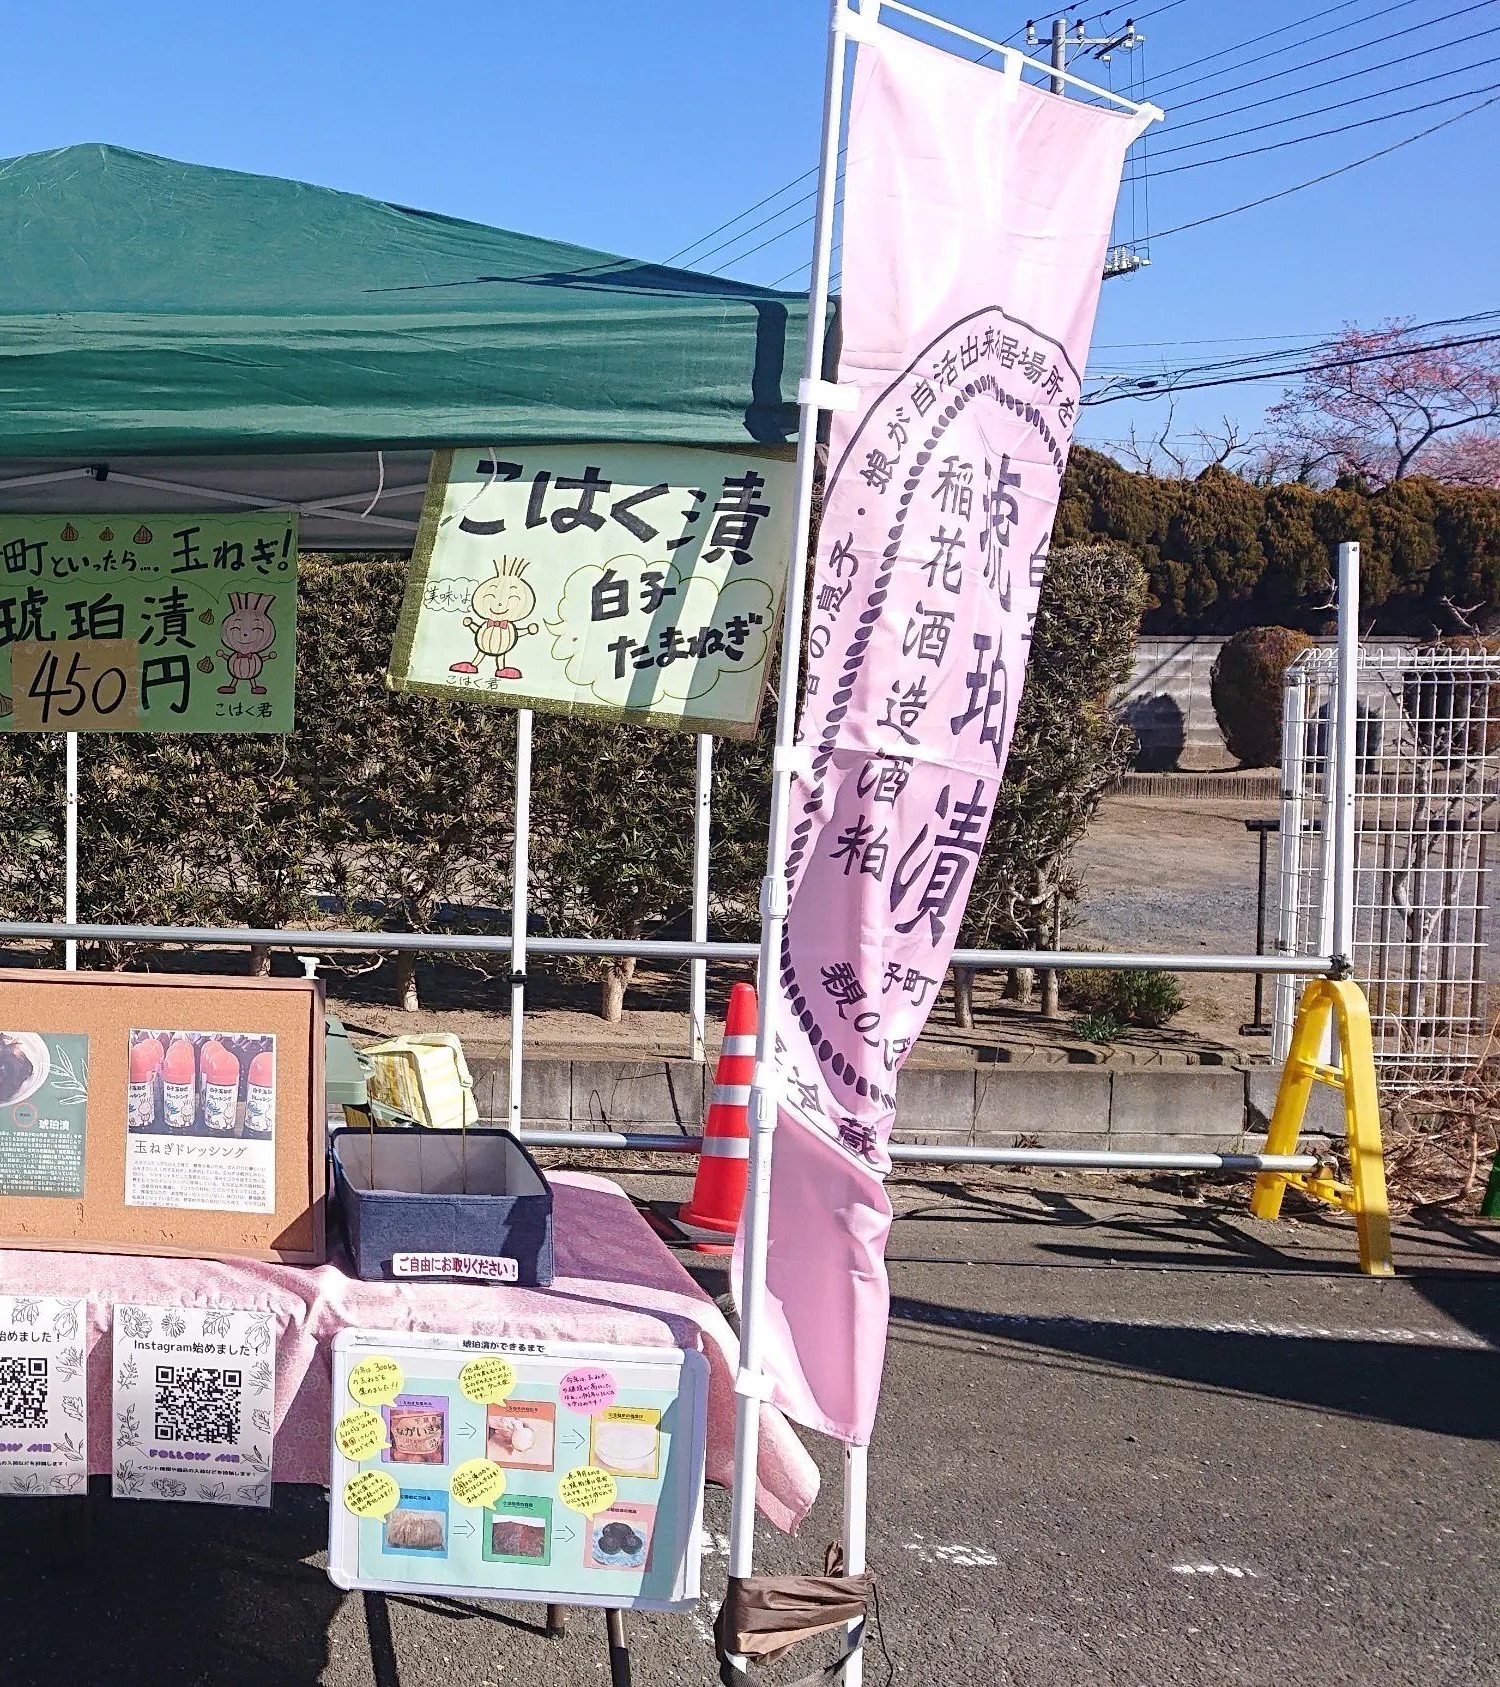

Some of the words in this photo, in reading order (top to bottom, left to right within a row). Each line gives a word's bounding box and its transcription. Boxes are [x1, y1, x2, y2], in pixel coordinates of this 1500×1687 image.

[458, 460, 772, 566] こはく漬
[428, 585, 471, 606] 美味いよ
[591, 568, 677, 622] 白子
[608, 612, 763, 679] たまねぎ
[28, 649, 191, 725] 450円
[446, 675, 502, 690] こはく君
[215, 702, 274, 719] こはく君
[134, 1140, 247, 1159] 玉ねぎドレッシング
[400, 1256, 516, 1278] ご自由にお取りください！
[134, 1340, 258, 1356] Instagram始めました！
[462, 1340, 545, 1352] 琥珀漬ができるまで
[26, 1443, 52, 1452] ME
[149, 1449, 211, 1461] FOLLOW
[214, 1453, 240, 1463] ME
